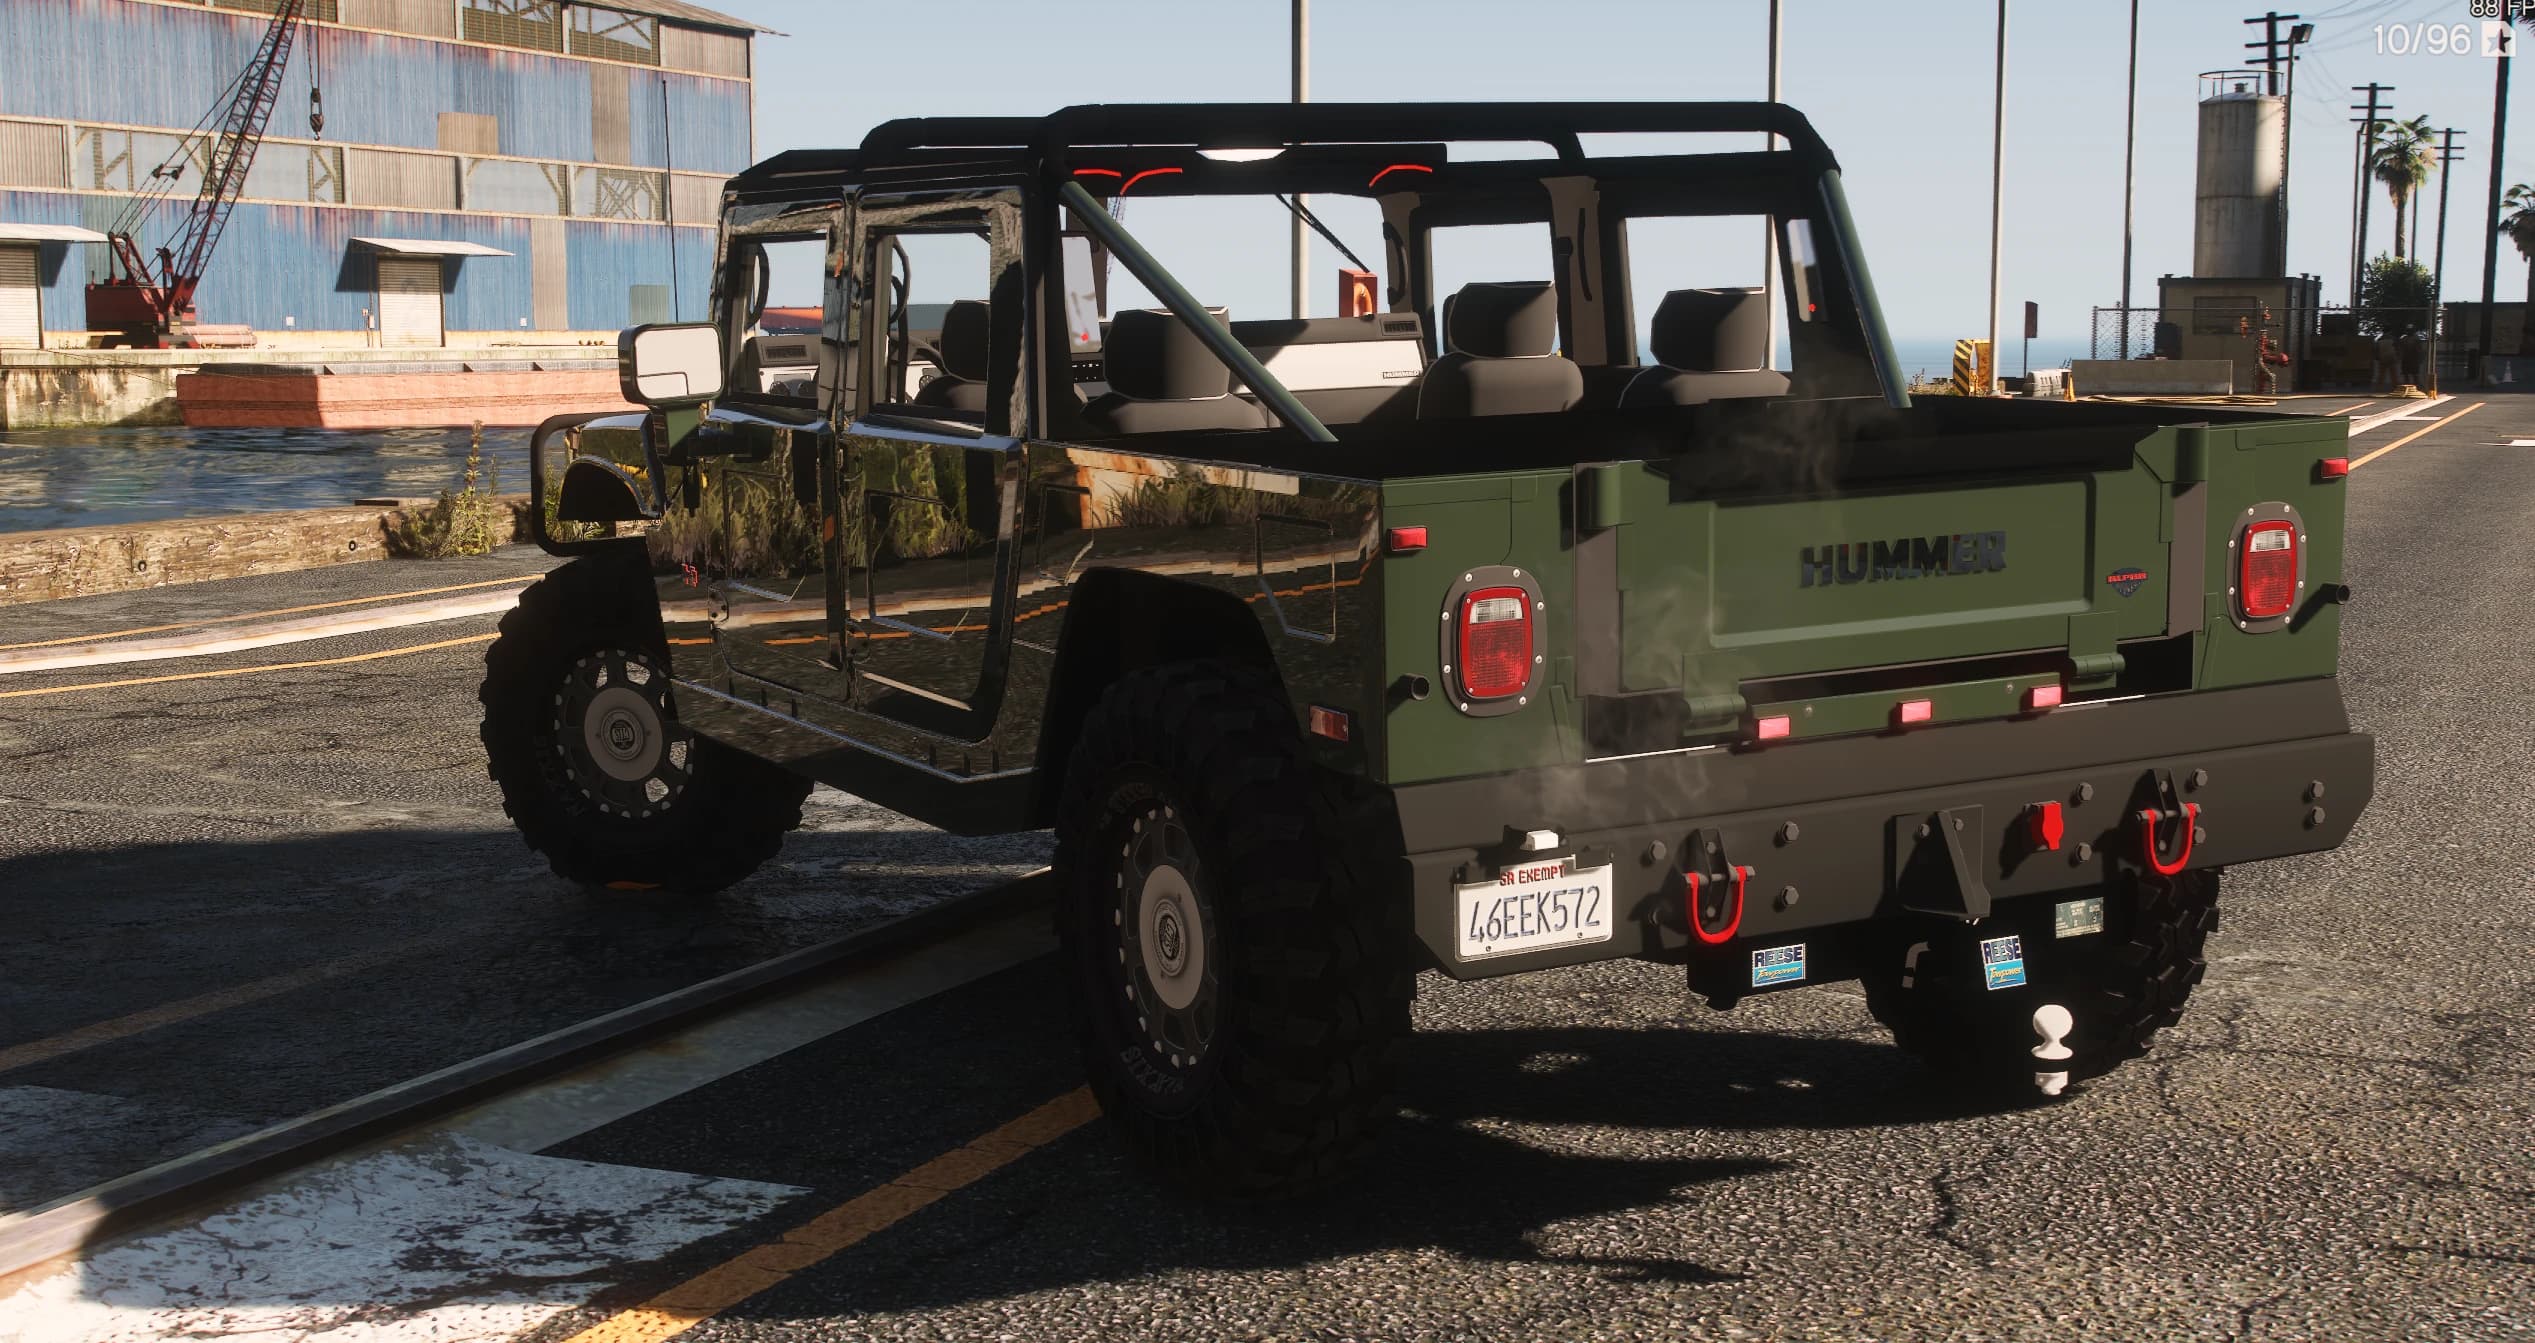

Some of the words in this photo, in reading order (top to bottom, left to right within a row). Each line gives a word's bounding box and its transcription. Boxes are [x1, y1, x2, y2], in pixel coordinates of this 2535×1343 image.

[1799, 530, 2007, 589] HUMMER
[1519, 864, 1566, 883] EXEMPT
[1469, 885, 1601, 942] 46EEK572
[1754, 946, 1803, 968] REESE
[1984, 937, 2022, 964] REESE
